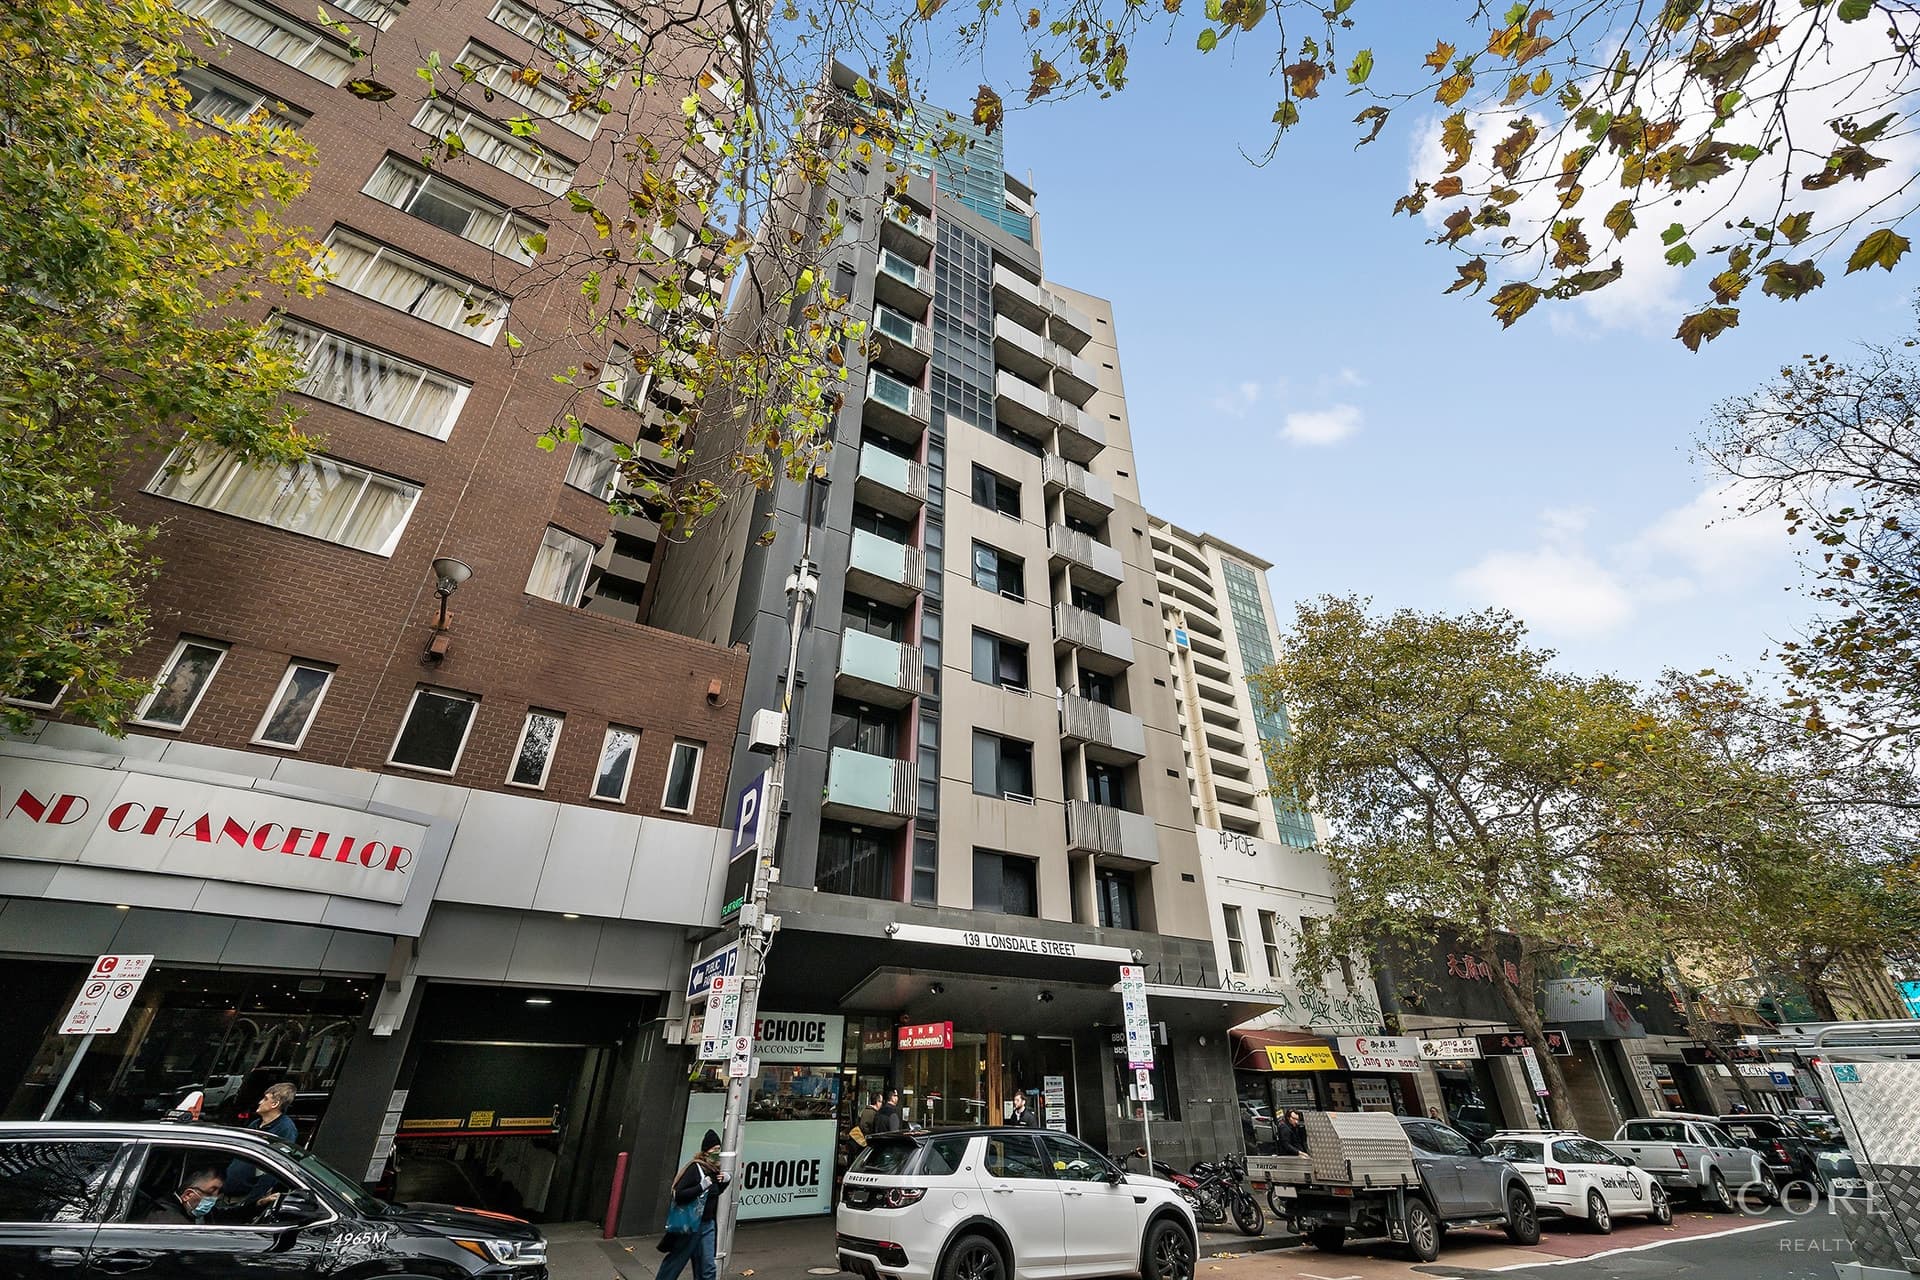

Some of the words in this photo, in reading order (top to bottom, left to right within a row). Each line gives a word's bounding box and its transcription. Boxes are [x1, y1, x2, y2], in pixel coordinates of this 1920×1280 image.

[736, 787, 757, 848] P
[0, 787, 90, 826] ND
[107, 801, 413, 874] CHANCELLOR
[963, 932, 980, 946] 139
[985, 935, 1038, 953] LONSDALE
[1041, 941, 1076, 956] STREET
[725, 995, 738, 1004] 2P
[1287, 1052, 1315, 1064] Snack
[1384, 1058, 1395, 1067] go
[1398, 1059, 1419, 1068] mama
[1774, 1073, 1784, 1083] P
[740, 1159, 821, 1191] CHOICE
[848, 1175, 879, 1183] DISCOVERY
[799, 1186, 819, 1194] STORES
[332, 1230, 390, 1246] 4965M
